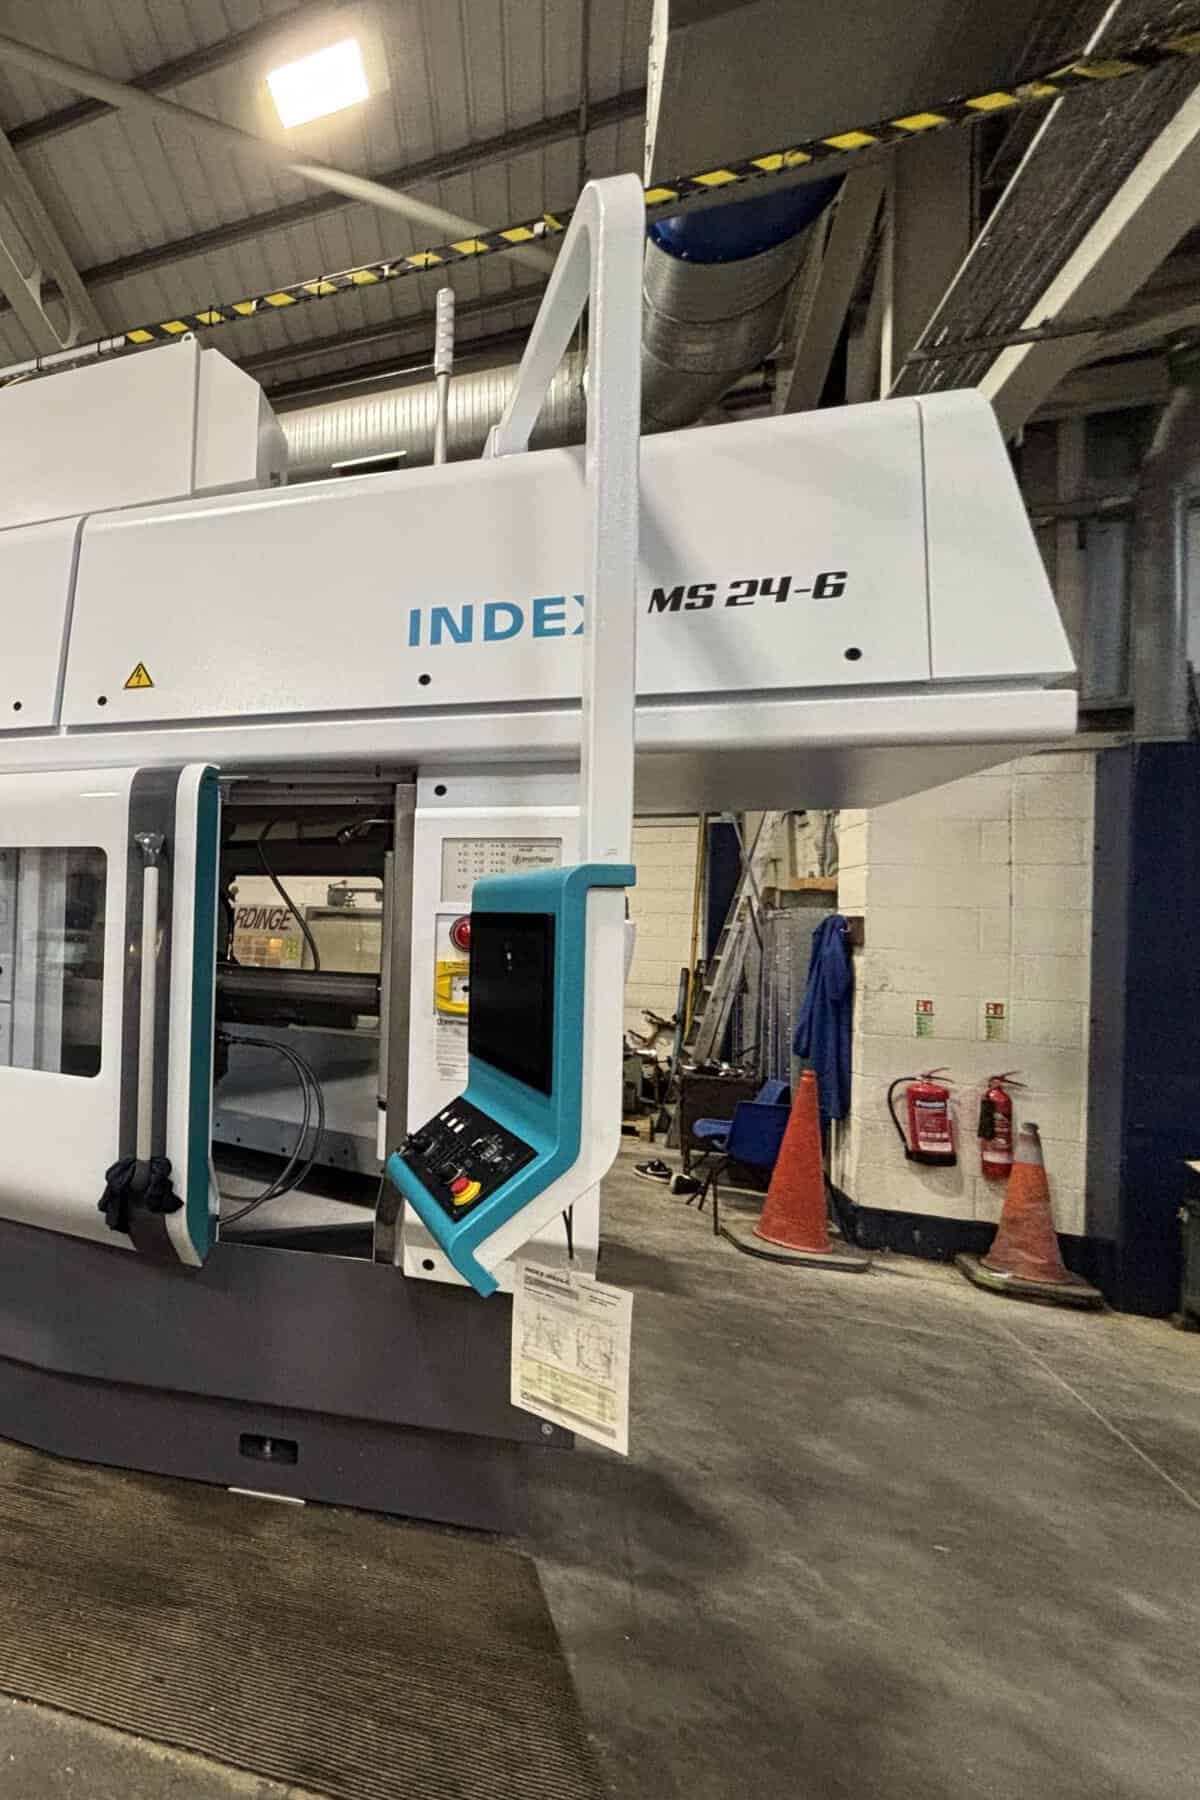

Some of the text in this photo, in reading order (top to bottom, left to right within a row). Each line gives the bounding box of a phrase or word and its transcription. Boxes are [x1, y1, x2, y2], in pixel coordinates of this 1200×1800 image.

[647, 583, 717, 614] MS
[726, 571, 848, 606] 24-6
[236, 907, 290, 930] RDINGE
